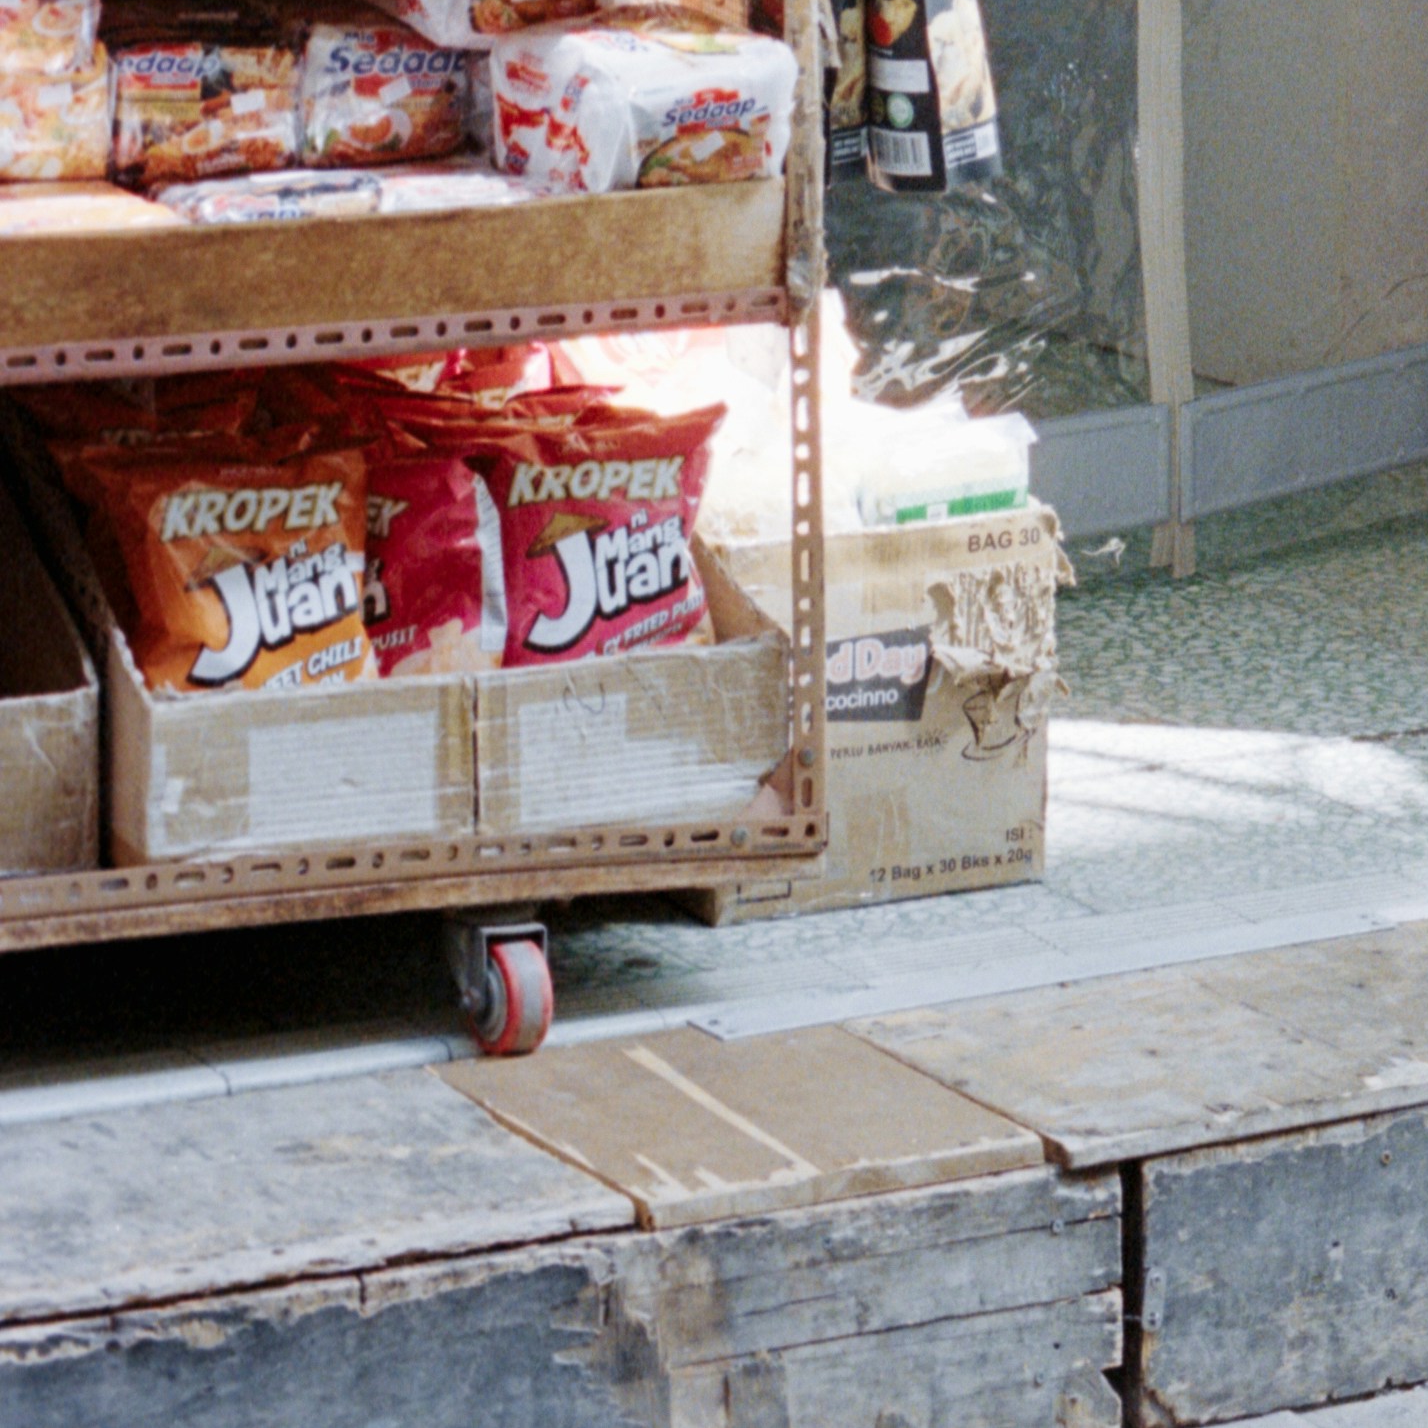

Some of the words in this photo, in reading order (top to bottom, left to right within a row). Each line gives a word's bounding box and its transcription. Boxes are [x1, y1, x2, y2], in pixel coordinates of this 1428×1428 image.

[115, 49, 218, 81] edaap
[662, 97, 757, 127] Sedaap
[506, 455, 685, 508] KROPEK
[161, 481, 343, 542] KROPEK
[630, 508, 648, 529] ni
[289, 536, 307, 558] ni
[595, 515, 684, 561] Mang
[967, 530, 1014, 554] BAG
[1018, 525, 1041, 547] 30
[254, 543, 345, 593] Mang
[525, 530, 690, 651] Juan
[188, 560, 359, 686] Juan
[623, 608, 671, 650] FRIED
[306, 636, 363, 677] CHILI
[854, 639, 928, 686] Day
[826, 688, 900, 713] cocinno
[890, 861, 922, 883] Bag
[925, 862, 935, 875] x
[939, 858, 957, 874] 30
[961, 851, 989, 872] Bks
[994, 854, 1004, 866] x
[1007, 848, 1034, 867] 20g
